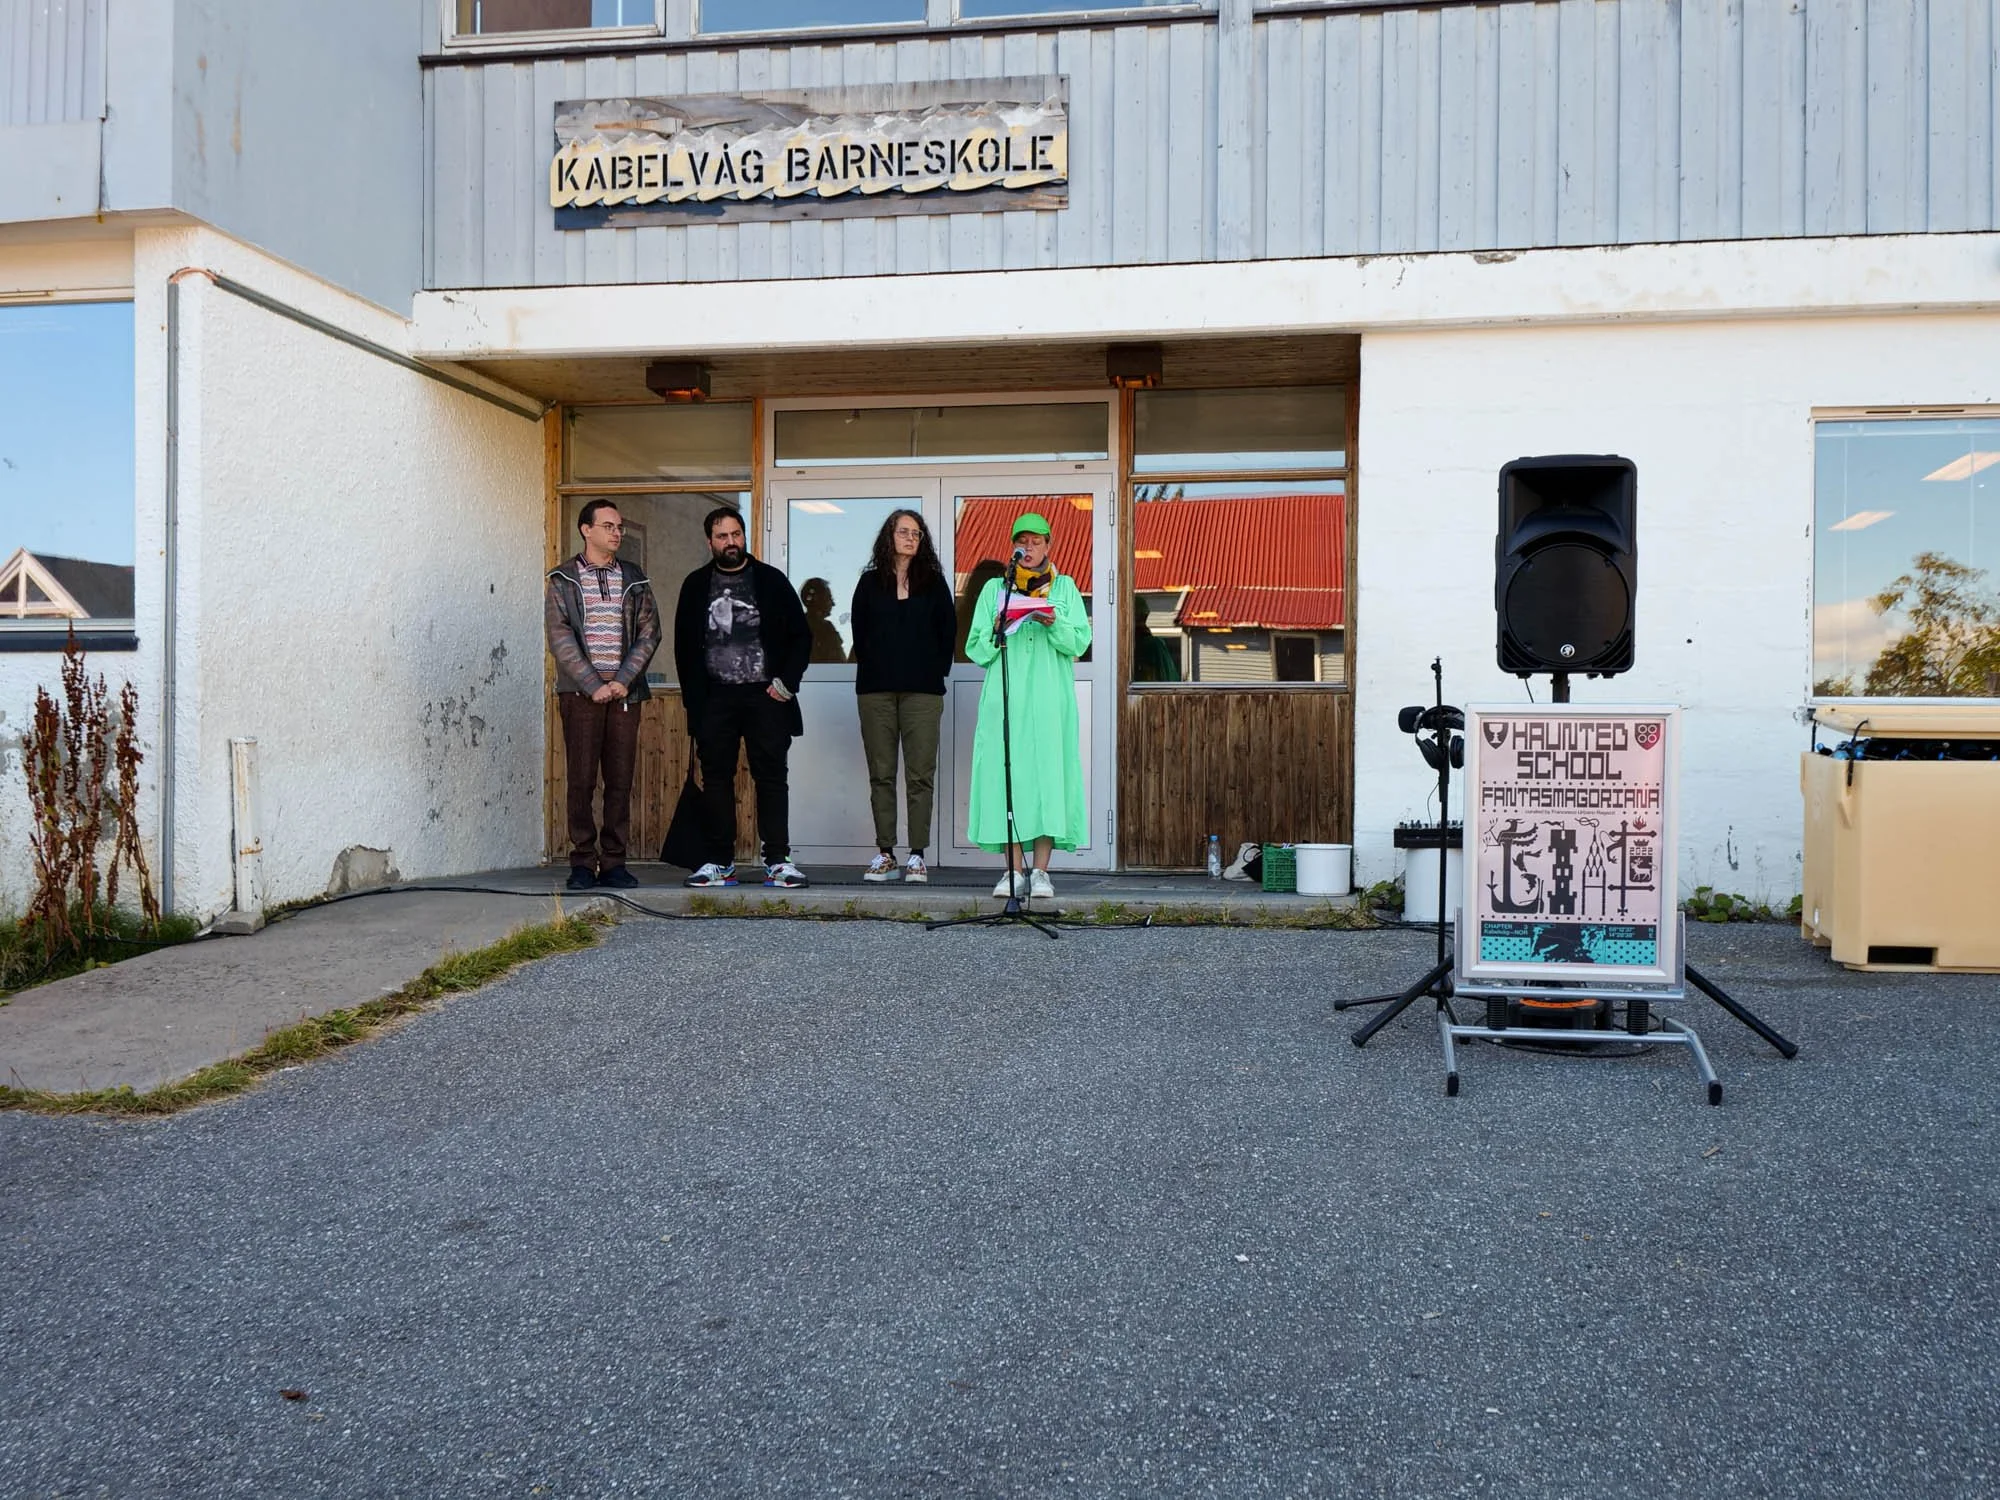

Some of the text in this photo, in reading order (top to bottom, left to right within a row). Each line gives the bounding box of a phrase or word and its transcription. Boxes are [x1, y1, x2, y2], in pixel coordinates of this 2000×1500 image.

[558, 135, 1054, 192] KABELVÅG BARNESKOLE
[1513, 722, 1628, 750] HAUNTED
[1517, 752, 1622, 780] SCHOOL
[1482, 787, 1660, 808] FANTASMAGORIANA
[1629, 847, 1653, 855] 2022
